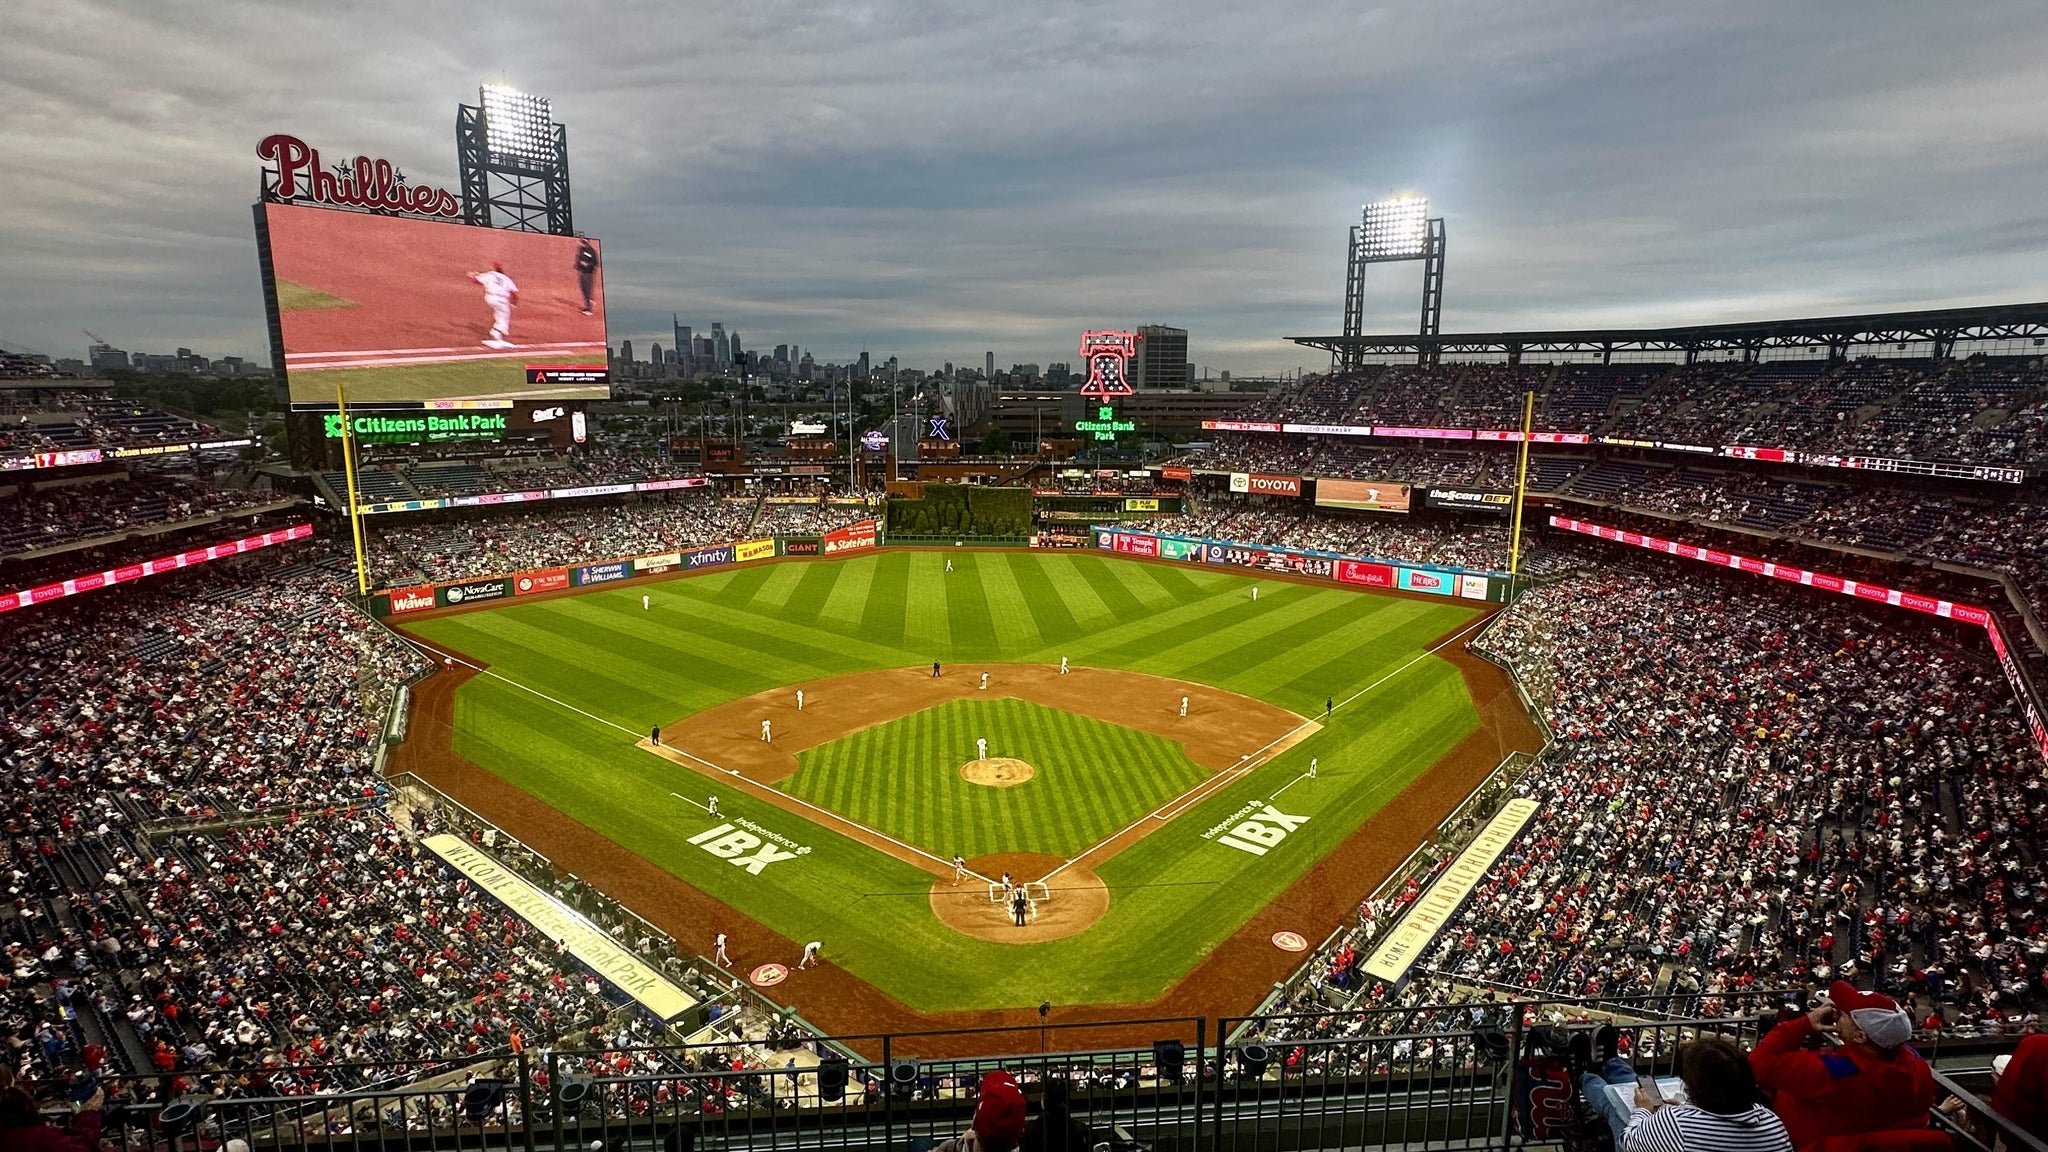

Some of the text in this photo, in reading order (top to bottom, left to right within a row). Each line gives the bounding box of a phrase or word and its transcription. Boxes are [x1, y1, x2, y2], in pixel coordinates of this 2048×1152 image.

[257, 134, 460, 217] Phillies
[355, 414, 506, 433] Citizens Bank Park
[1075, 421, 1135, 431] Citizens Bank
[1094, 431, 1115, 441] Park
[709, 449, 732, 457] GIANT
[1251, 478, 1297, 492] TOYOTA
[1430, 489, 1509, 503] theScore BET
[787, 543, 818, 553] GIANT
[837, 537, 875, 550] State Farm
[1131, 537, 1154, 547] Temple
[1132, 545, 1152, 555] Health
[689, 549, 728, 567] xfinity
[591, 564, 622, 576] SHERWIN
[1741, 560, 1763, 571] TOYOTA
[116, 568, 140, 579] TOYOTA
[1775, 569, 1801, 579] TOYOTA
[77, 577, 103, 589] TOYOTA
[464, 582, 504, 596] NovaCare
[1814, 577, 1840, 588] TOYOTA
[34, 587, 63, 599] TOYOTA
[1857, 586, 1886, 598] TOYOTA
[393, 596, 433, 611] Wawa
[1903, 596, 1935, 610] TOYOTA
[1200, 806, 1255, 840] Independence
[734, 816, 799, 849] Independence
[1216, 804, 1312, 856] IBX
[686, 822, 798, 876] IBX
[1379, 802, 1531, 968] HOME PHILADELPHIA PHILLIES
[445, 846, 514, 890] WELCOME
[613, 966, 664, 1001] Park
